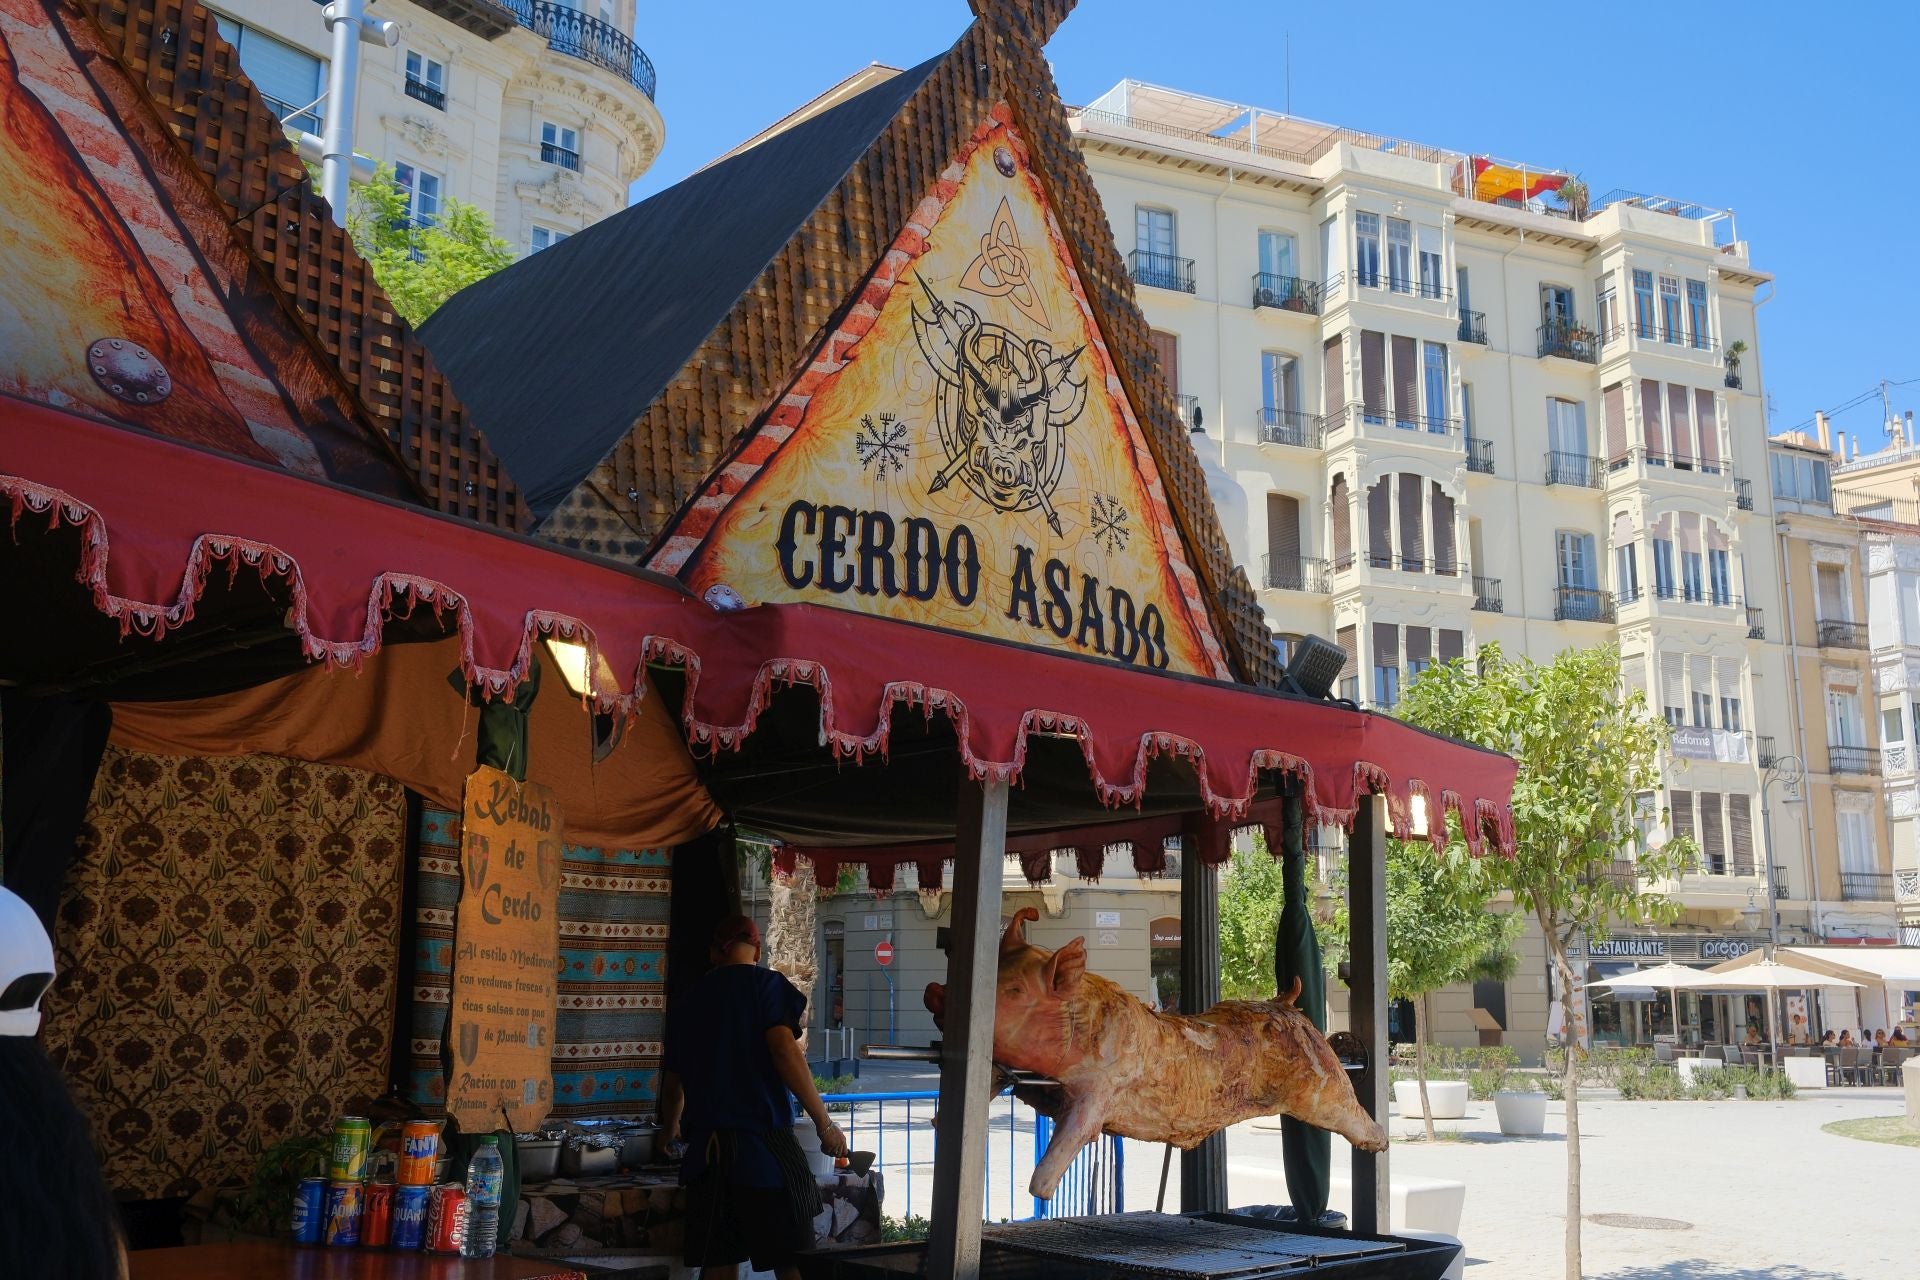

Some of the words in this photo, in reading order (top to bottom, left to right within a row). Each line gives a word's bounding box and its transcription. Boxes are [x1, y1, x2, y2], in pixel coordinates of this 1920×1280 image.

[774, 500, 982, 607] CERDO
[1004, 544, 1170, 670] ASADO
[1672, 734, 1710, 745] Reforma
[474, 780, 551, 832] Kebab
[504, 839, 525, 870] de
[481, 883, 542, 925] Cerdo
[457, 942, 476, 961] Al
[480, 946, 507, 962] estilo
[510, 949, 555, 970] Medieval
[1589, 940, 1664, 956] RESTAURANTE
[1703, 941, 1749, 959] prego
[460, 974, 474, 985] con
[478, 975, 513, 990] verduras
[462, 998, 483, 1013] ricas
[486, 1001, 514, 1015] salsas
[516, 1007, 529, 1017] con
[532, 1009, 545, 1021] pan
[484, 1028, 493, 1041] de
[496, 1029, 526, 1046] Pueblo
[459, 1072, 497, 1094] Ración
[500, 1079, 516, 1090] con
[454, 1097, 487, 1114] Patatas
[333, 1152, 349, 1163] tea
[334, 1143, 357, 1157] fuze
[394, 1207, 427, 1222] QUARI
